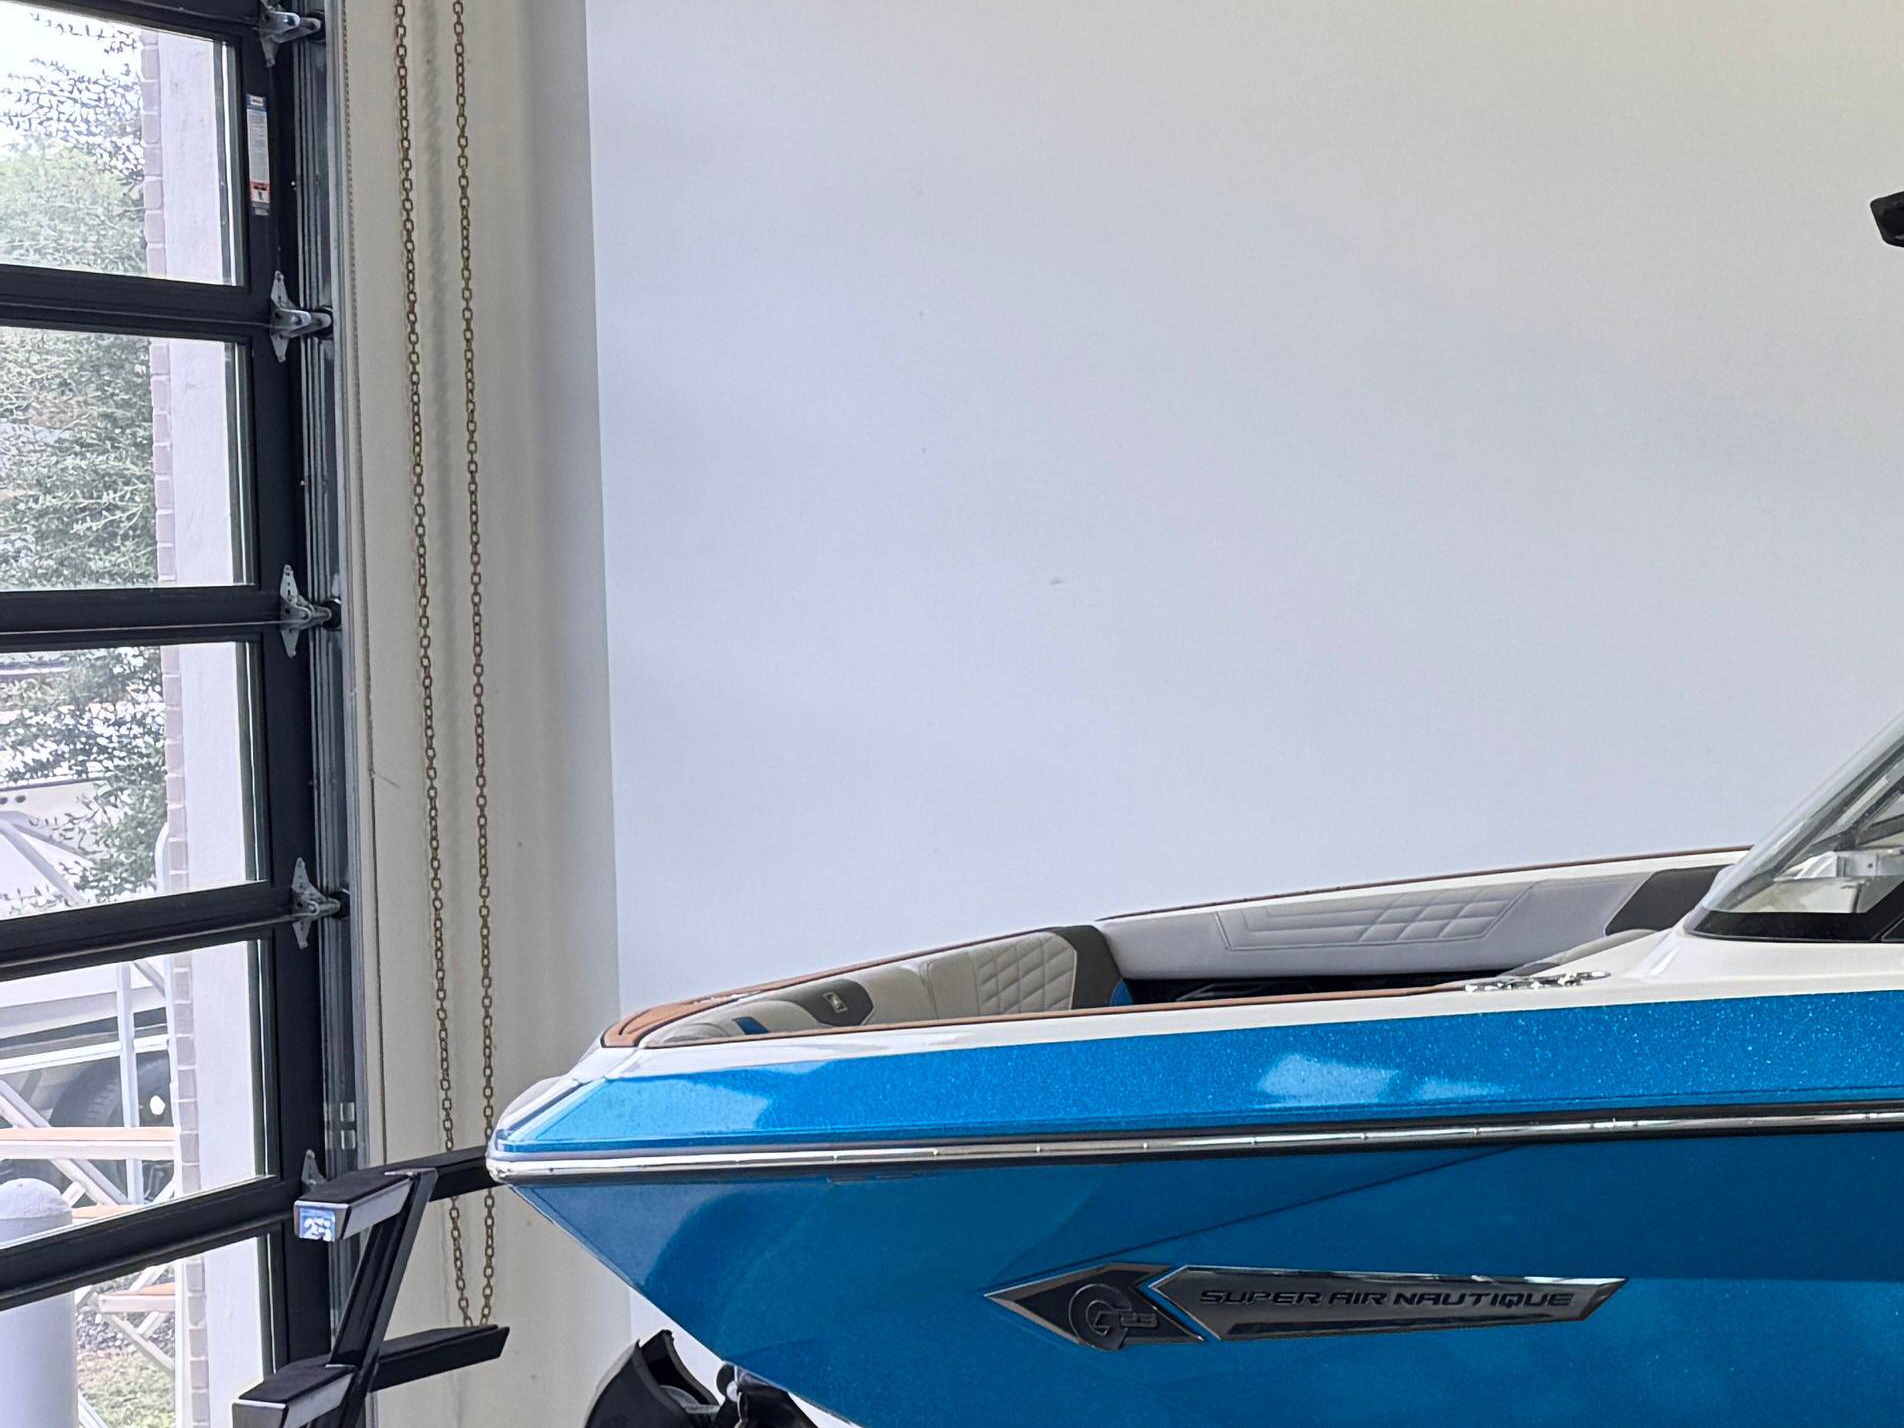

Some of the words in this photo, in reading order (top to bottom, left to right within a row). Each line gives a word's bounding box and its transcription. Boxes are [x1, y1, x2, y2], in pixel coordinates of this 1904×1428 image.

[1200, 1289, 1322, 1306] SUPER
[1328, 1290, 1387, 1307] AIR
[1393, 1290, 1576, 1309] NAUTIQUE
